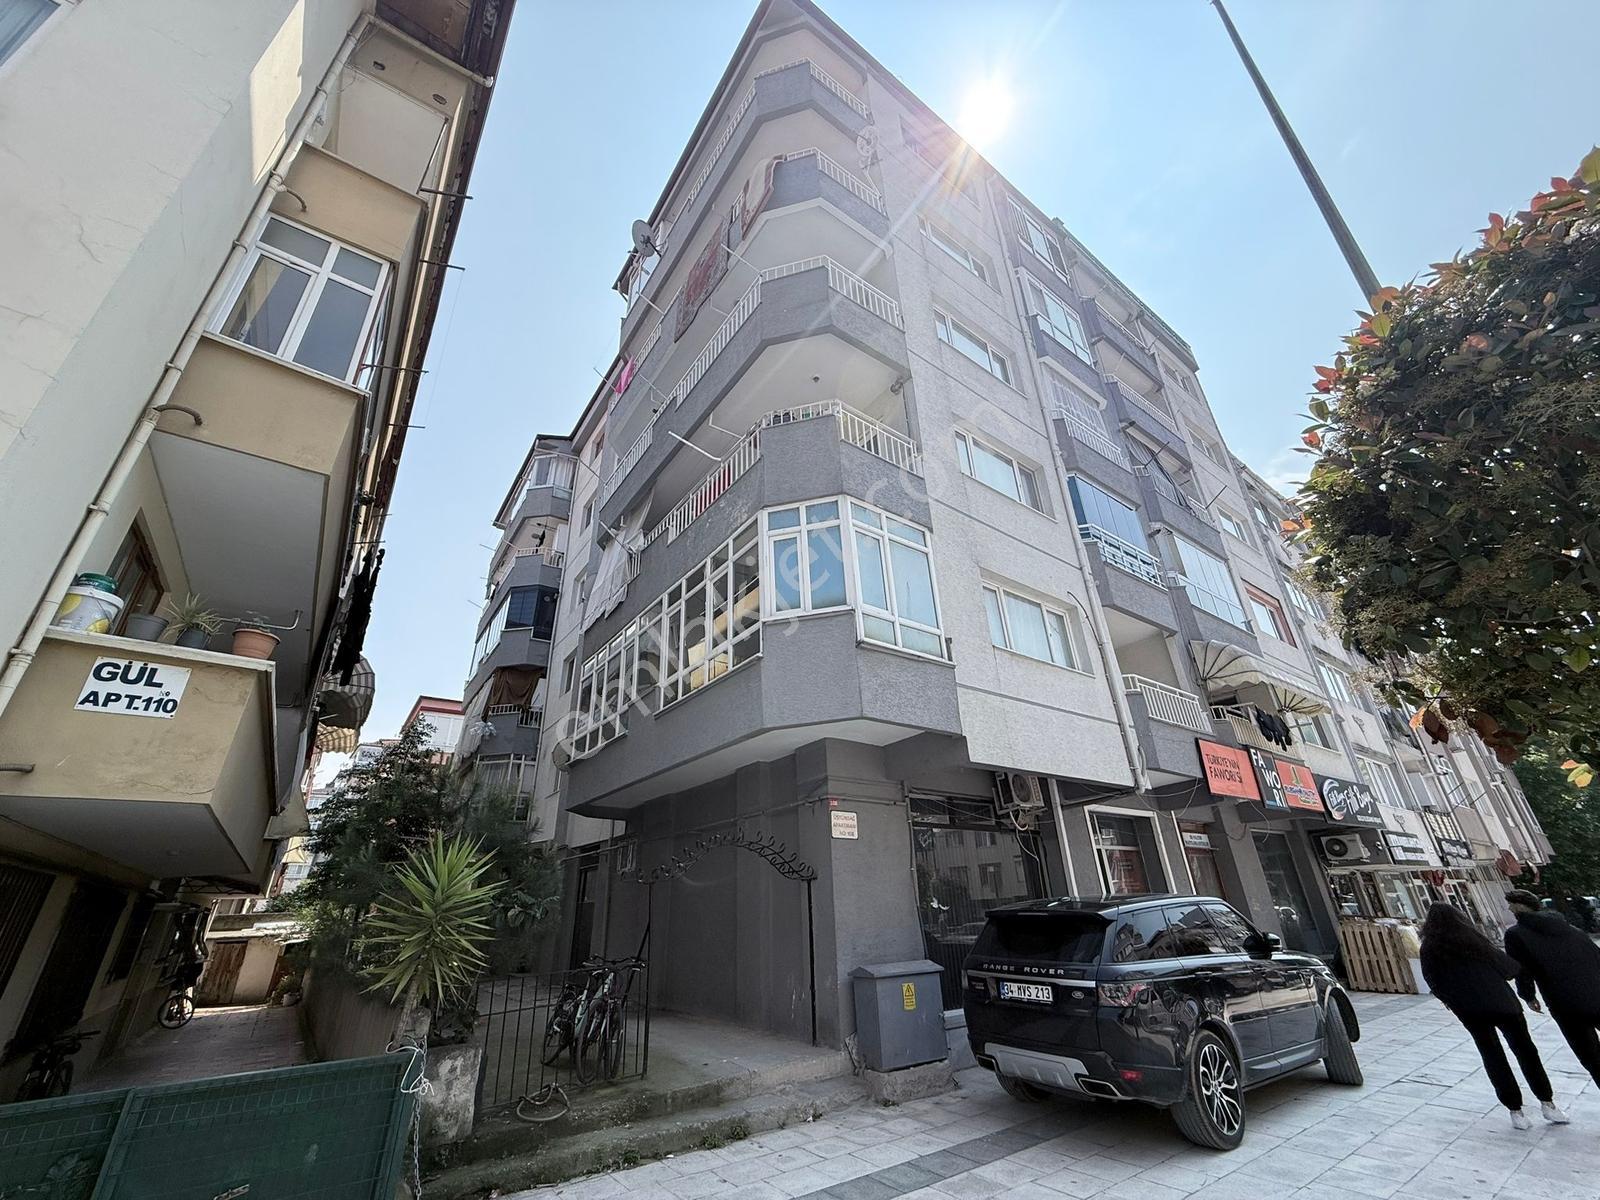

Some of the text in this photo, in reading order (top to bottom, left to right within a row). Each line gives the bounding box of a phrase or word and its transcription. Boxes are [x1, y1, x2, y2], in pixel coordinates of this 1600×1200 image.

[92, 661, 164, 688] GÜL
[1249, 748, 1266, 769] FA
[1261, 768, 1281, 789] WO
[982, 963, 1065, 975] RANGE ROVER
[1004, 983, 1051, 1000] 34 MVS 213
